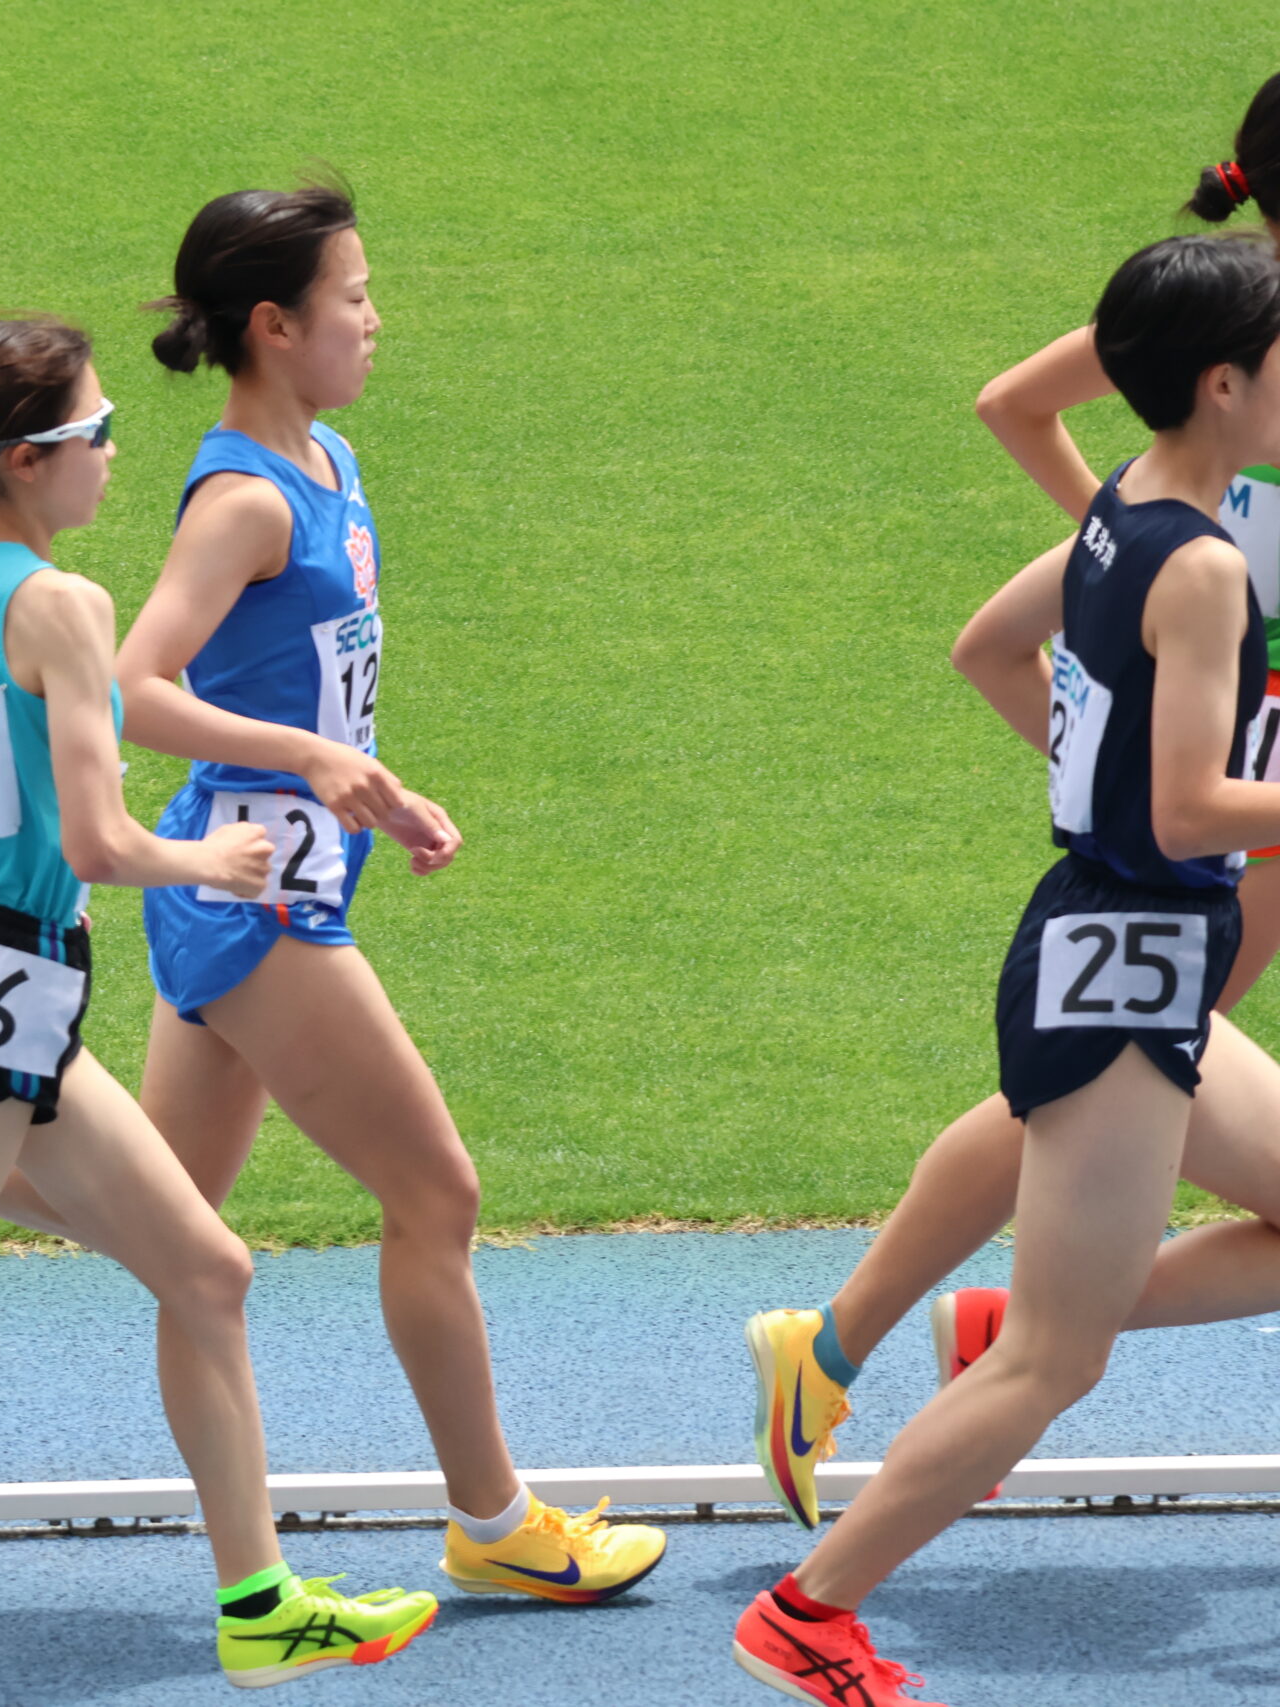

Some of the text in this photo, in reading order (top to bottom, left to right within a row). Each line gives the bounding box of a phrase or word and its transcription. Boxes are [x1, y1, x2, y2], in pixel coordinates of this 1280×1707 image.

[1220, 484, 1252, 518] M
[341, 651, 377, 723] 12
[237, 804, 318, 894] 2
[1061, 922, 1179, 1015] 25
